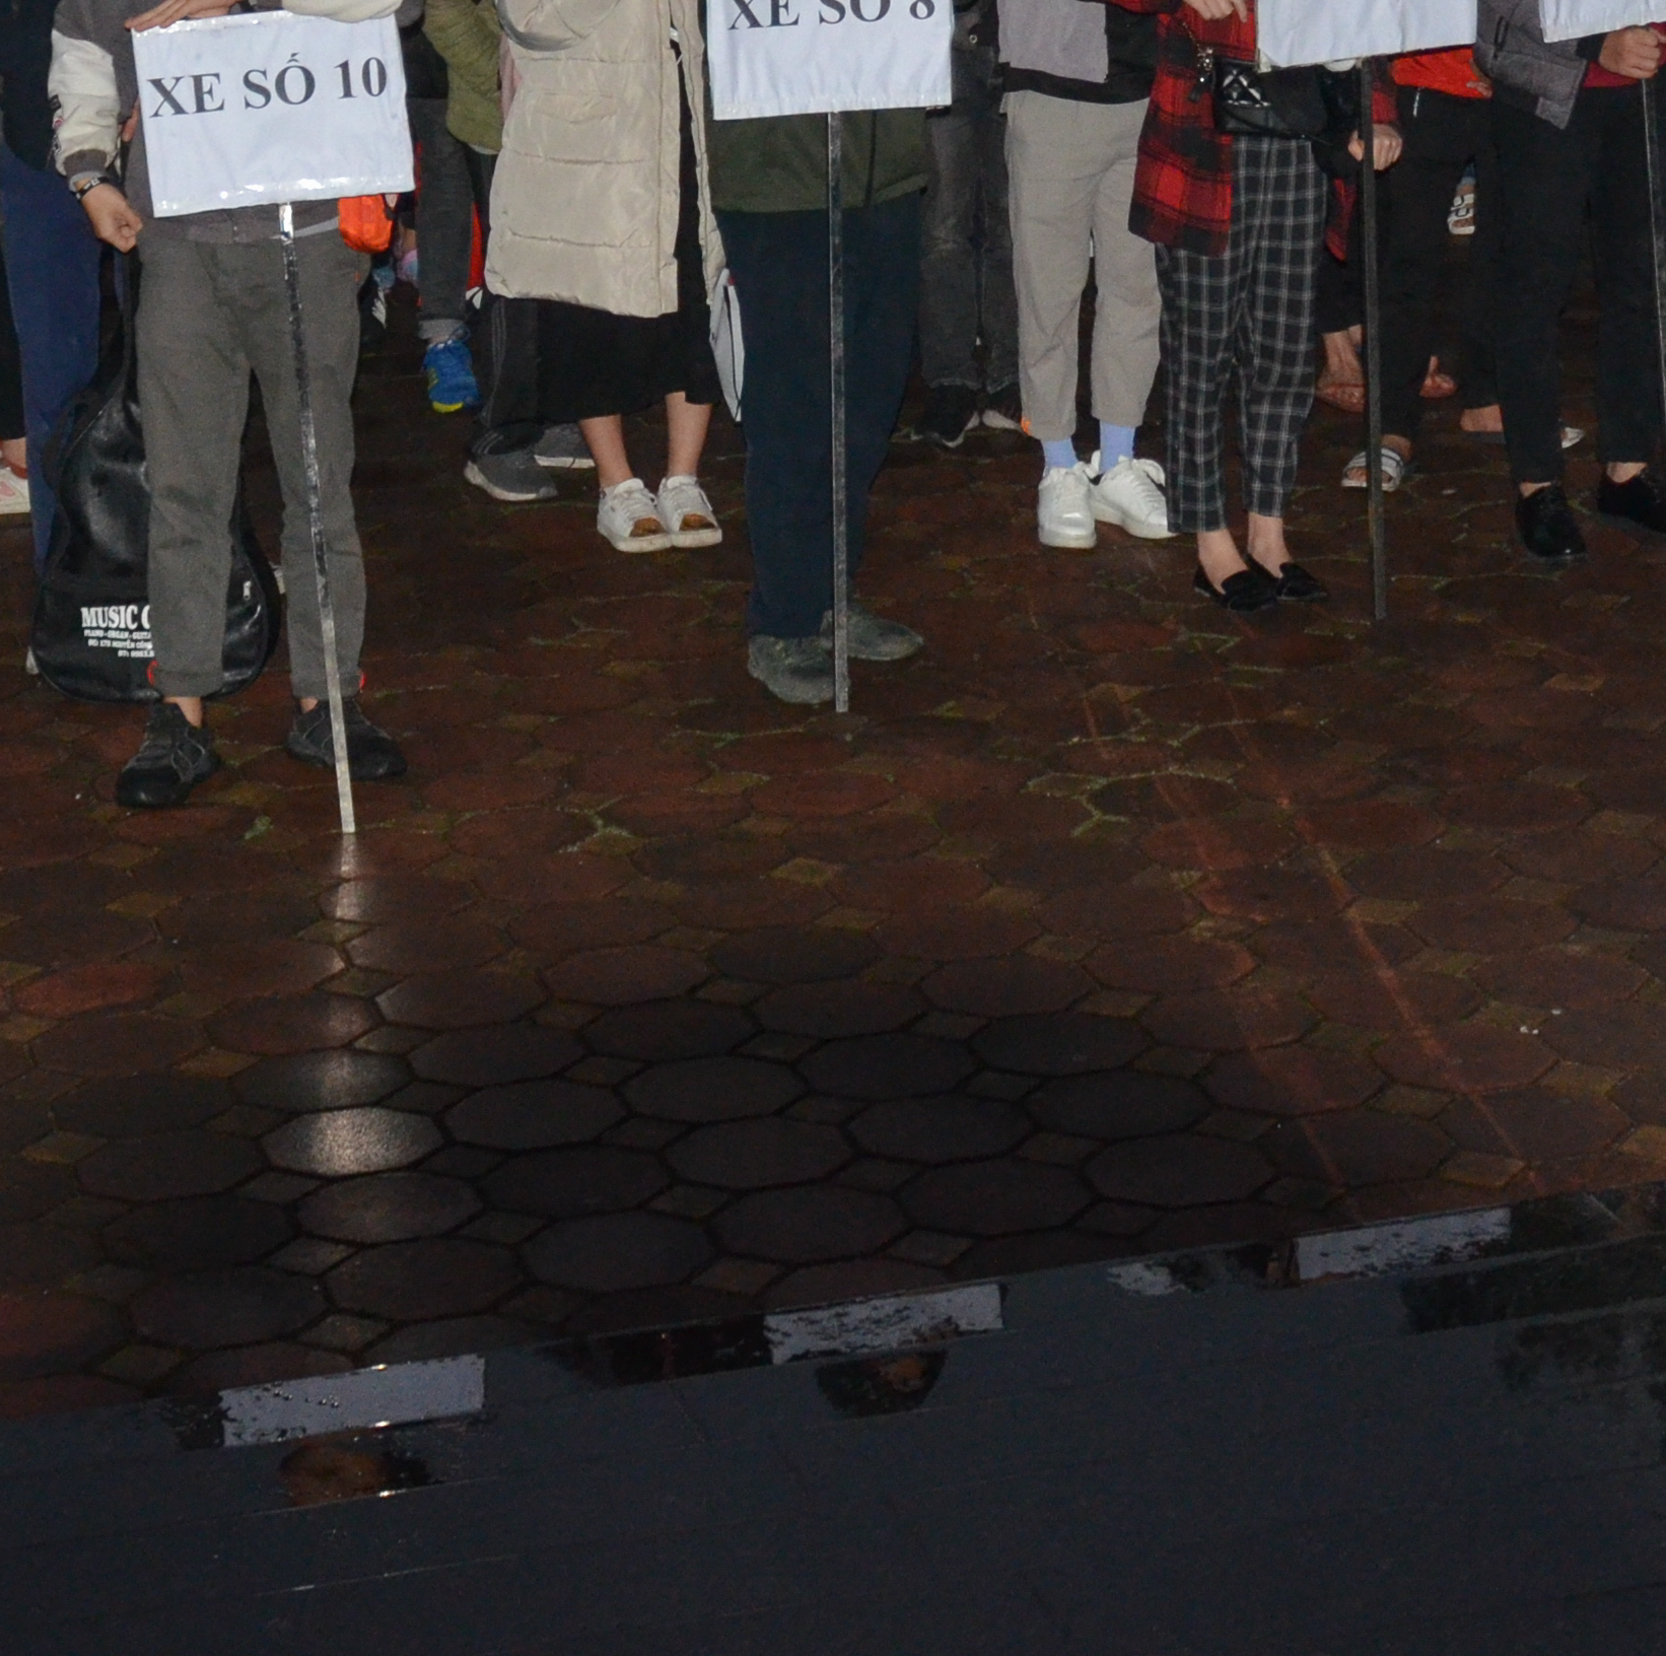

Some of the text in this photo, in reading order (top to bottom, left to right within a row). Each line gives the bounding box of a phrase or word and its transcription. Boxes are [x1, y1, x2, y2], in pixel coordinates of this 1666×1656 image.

[148, 52, 388, 119] XE SỐ 10
[80, 604, 139, 630] MUSIC
